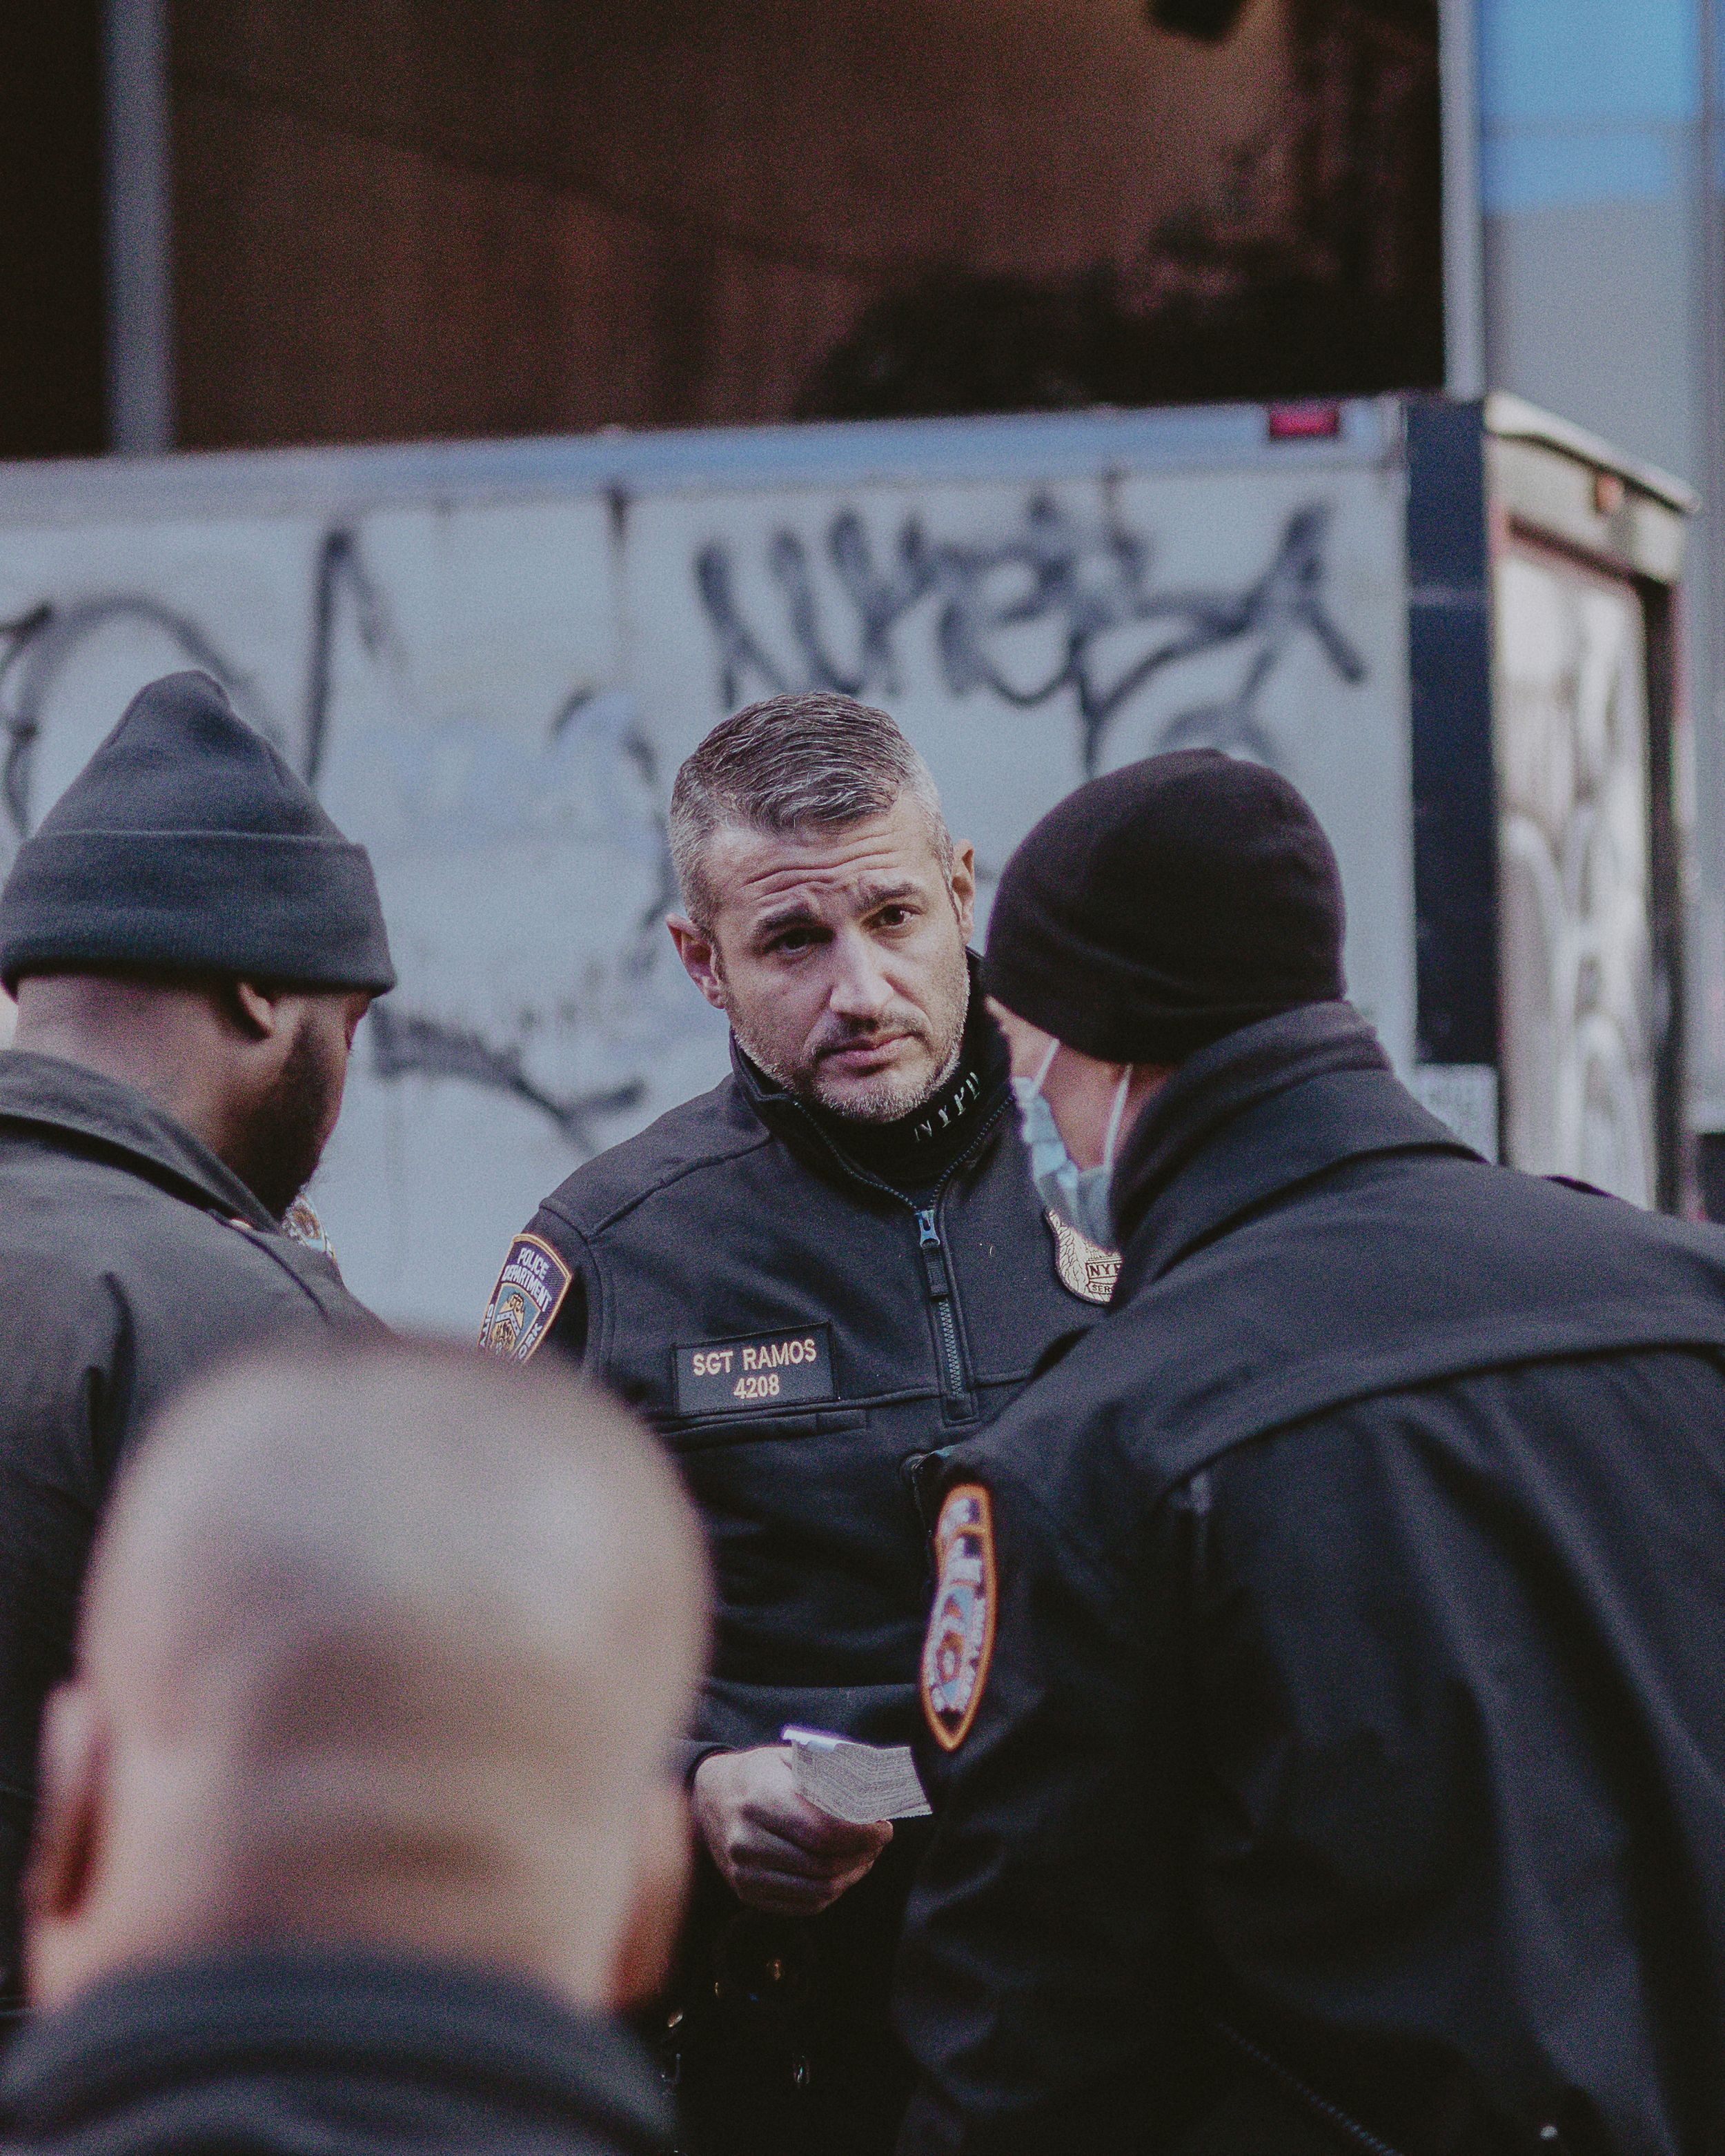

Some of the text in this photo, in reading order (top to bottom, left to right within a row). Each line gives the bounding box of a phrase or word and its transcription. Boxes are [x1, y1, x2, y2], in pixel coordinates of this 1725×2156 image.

[518, 1247, 549, 1280] POLICE
[1089, 1263, 1122, 1276] NYP
[501, 1265, 552, 1312] DEPARTMENT
[518, 1323, 542, 1361] ORK
[693, 1338, 817, 1376] SGT RAMOS
[733, 1374, 780, 1399] 4208
